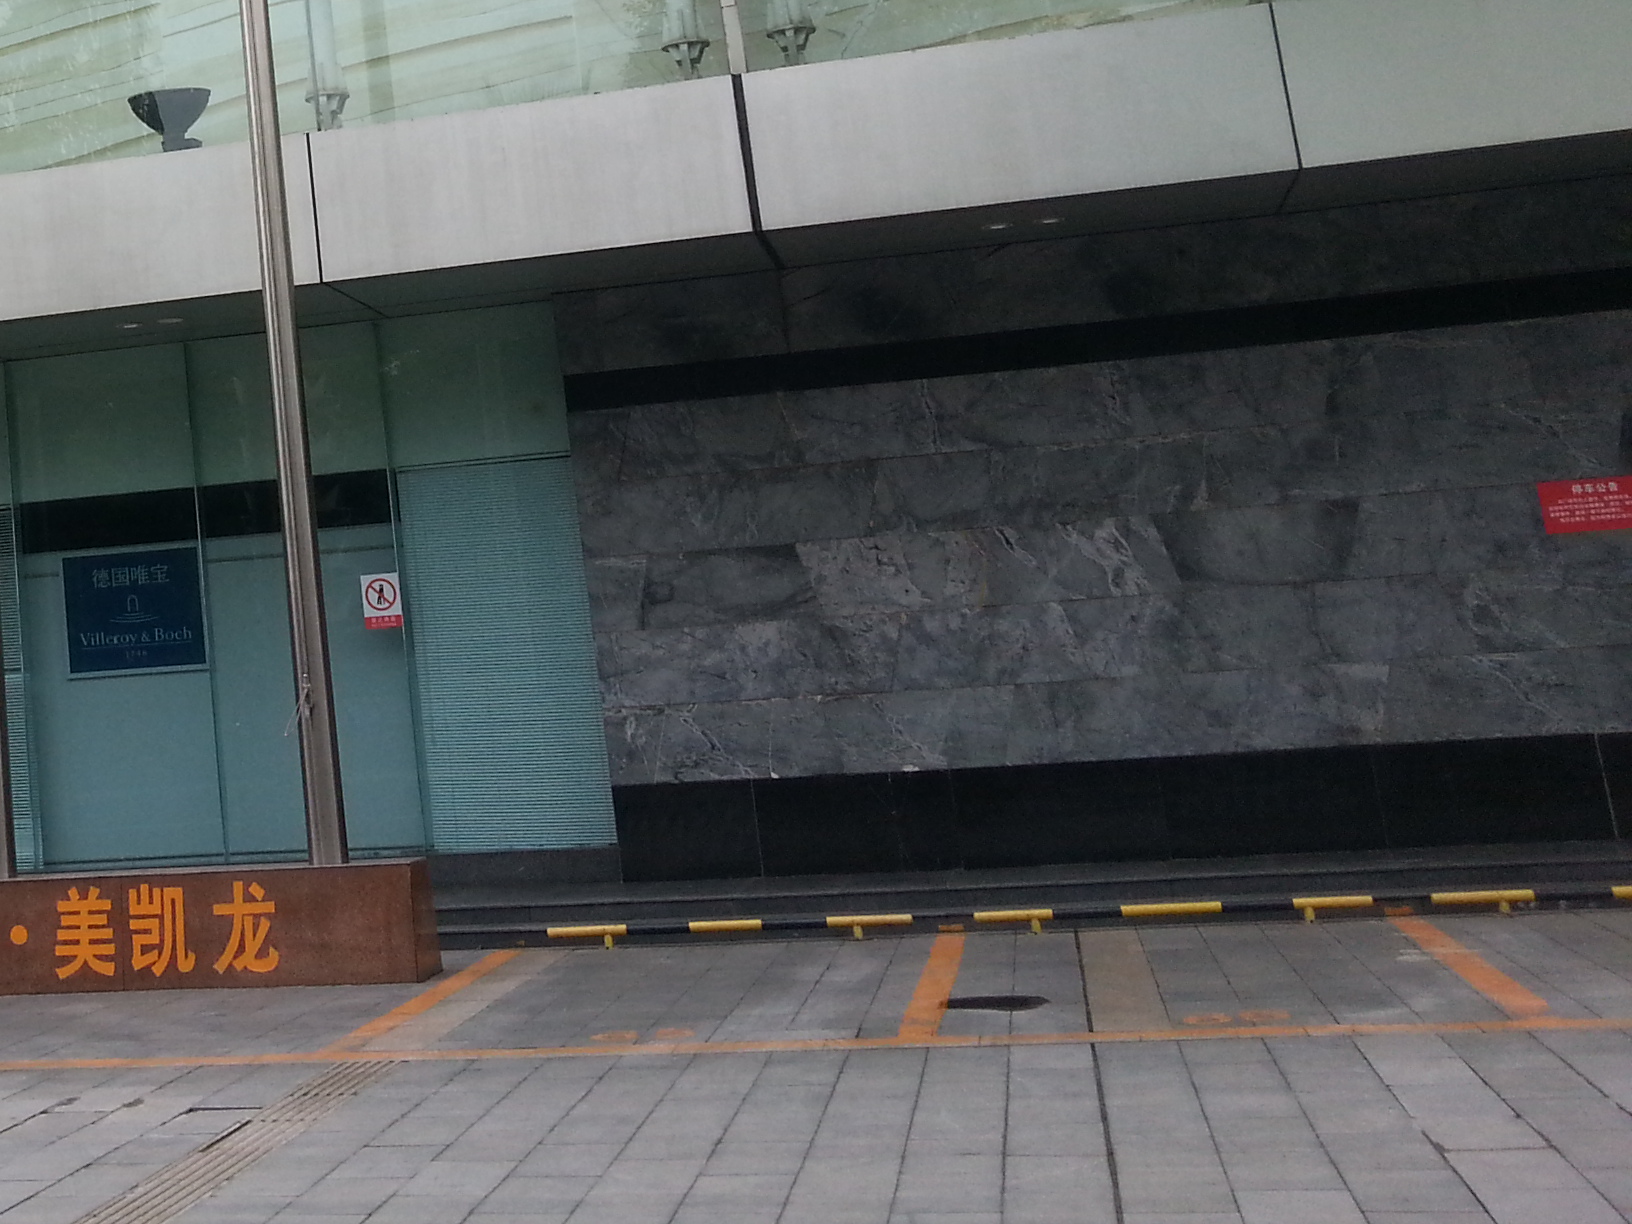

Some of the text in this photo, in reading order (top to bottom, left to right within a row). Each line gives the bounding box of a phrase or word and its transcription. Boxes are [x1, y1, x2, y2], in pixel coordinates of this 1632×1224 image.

[92, 564, 170, 588] 德国唯宝
[80, 626, 192, 647] Villeroy & Boch
